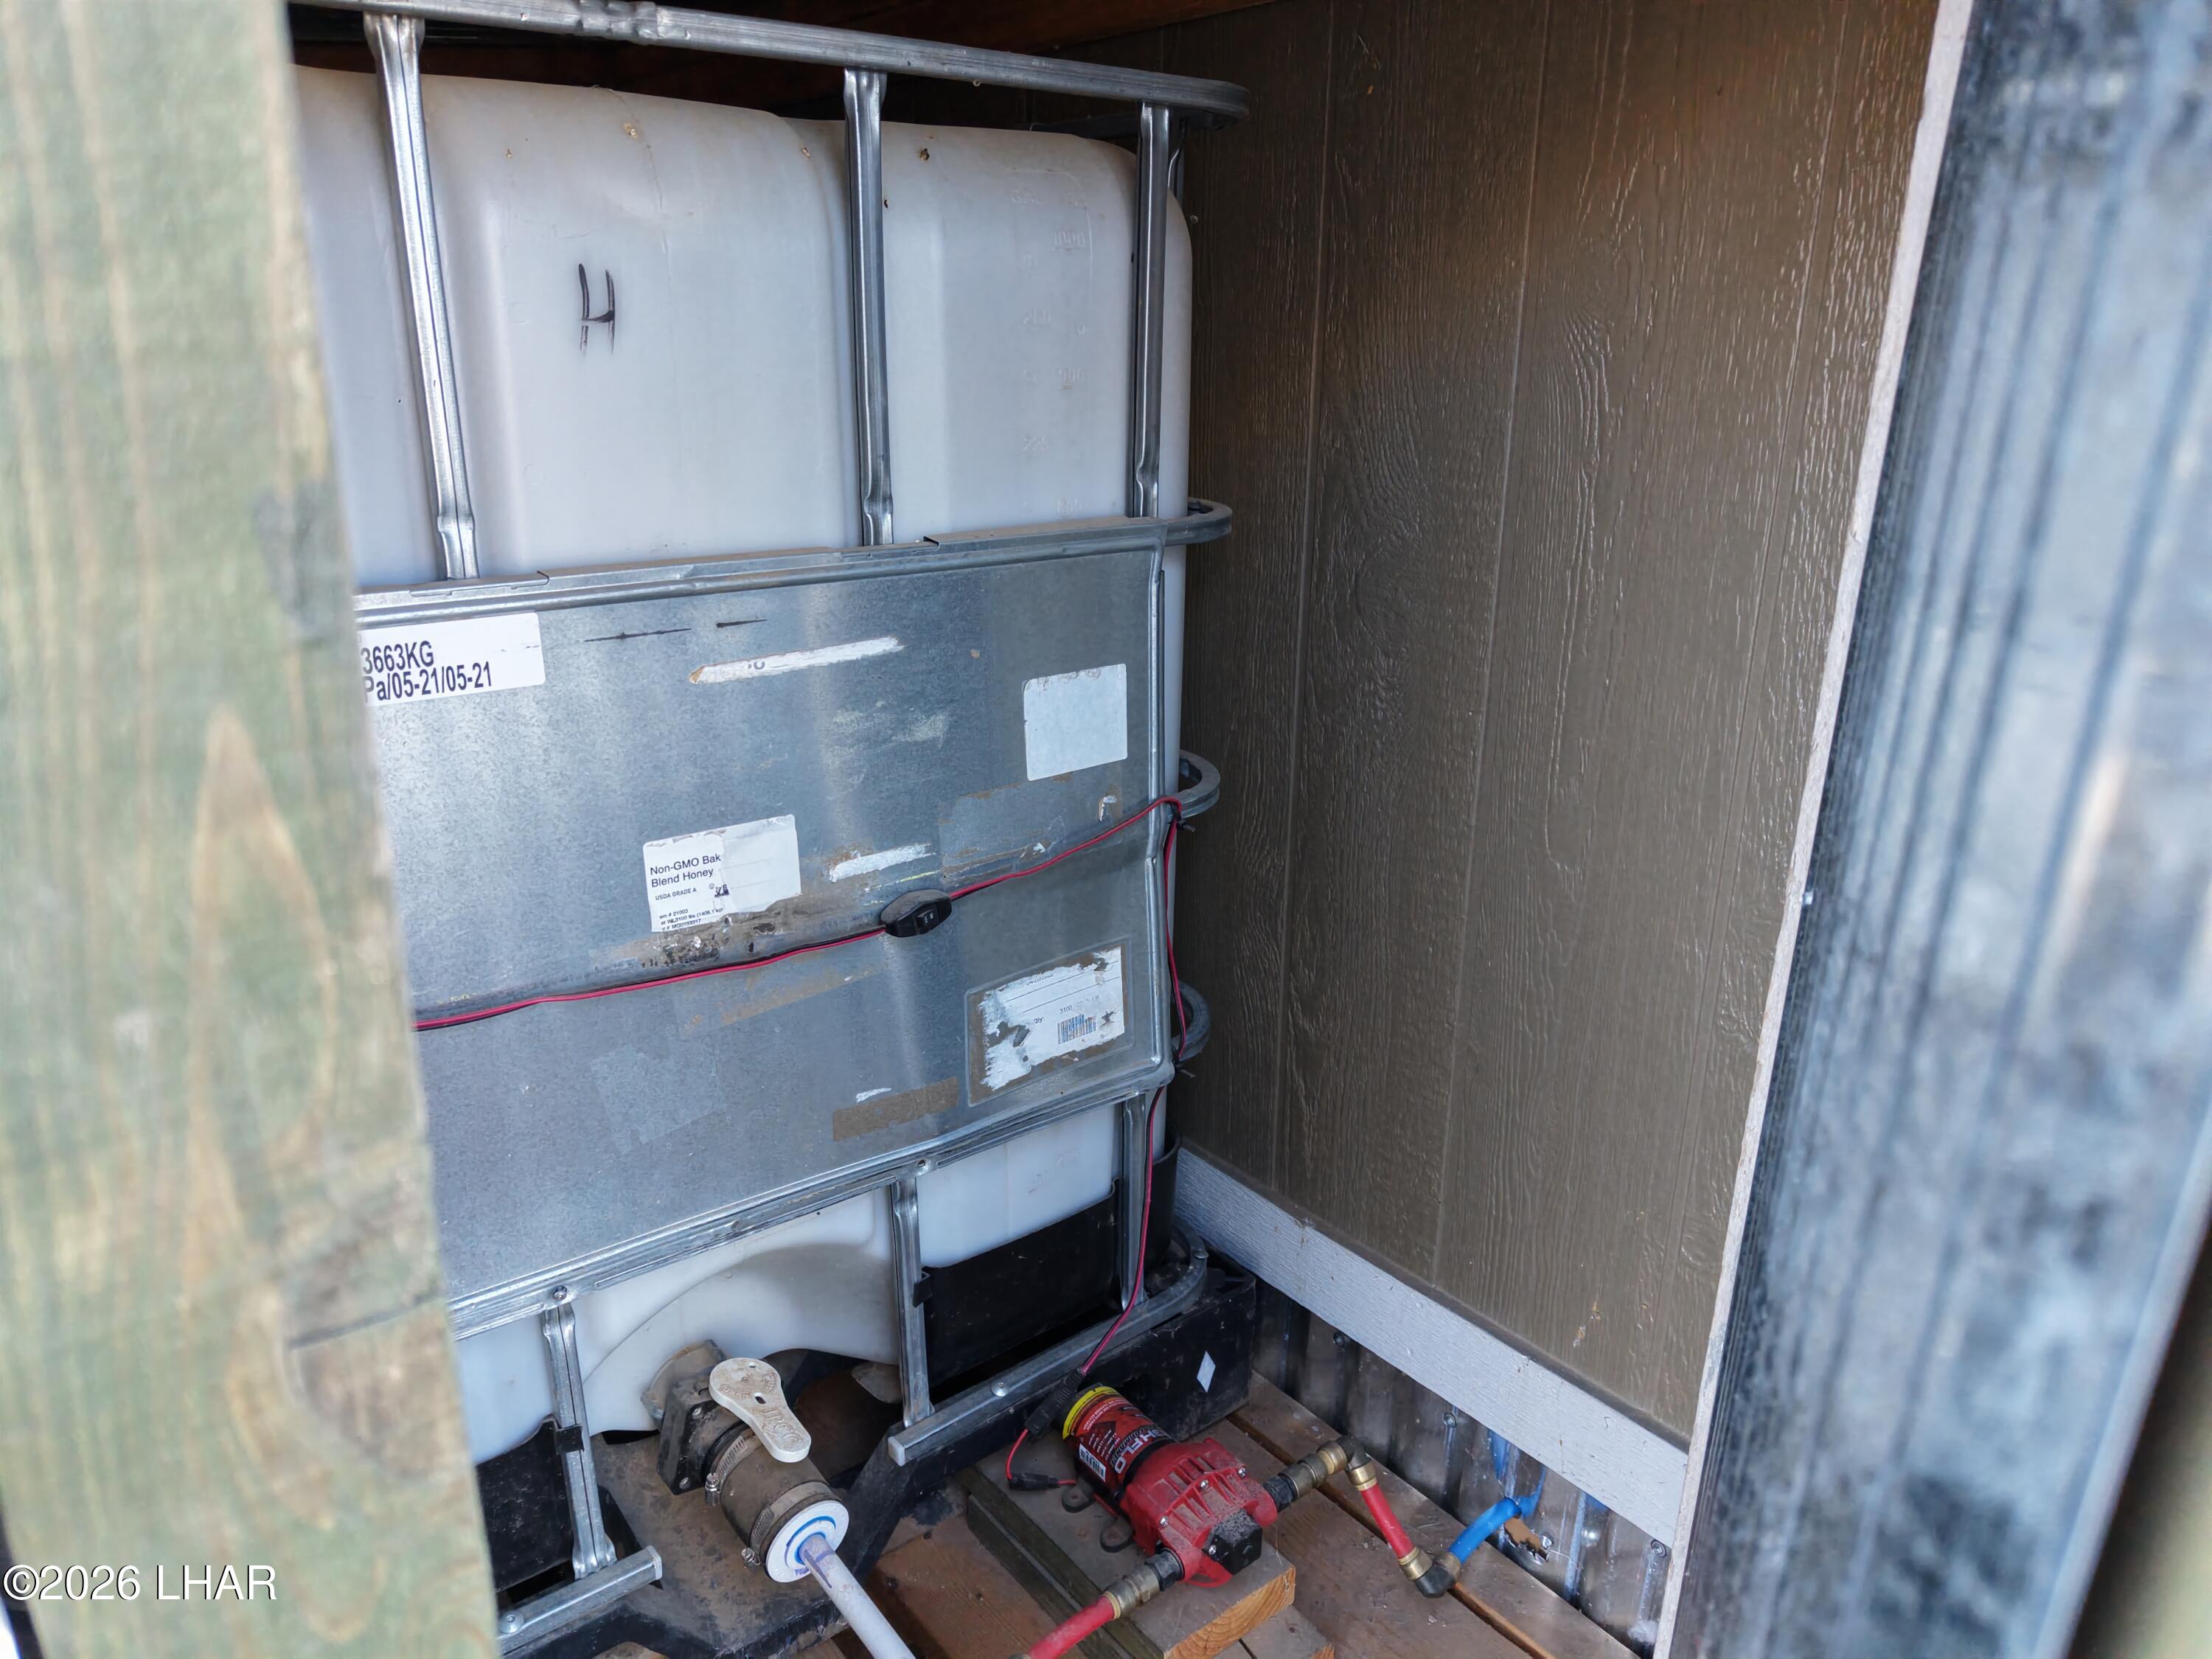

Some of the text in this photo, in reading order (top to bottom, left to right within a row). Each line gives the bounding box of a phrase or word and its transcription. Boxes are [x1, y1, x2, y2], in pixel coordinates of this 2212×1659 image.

[361, 640, 434, 675] 3663KG
[650, 853, 721, 875] Non-GMO Bak
[651, 869, 714, 888] Blend Honey
[672, 888, 691, 897] GRADE
